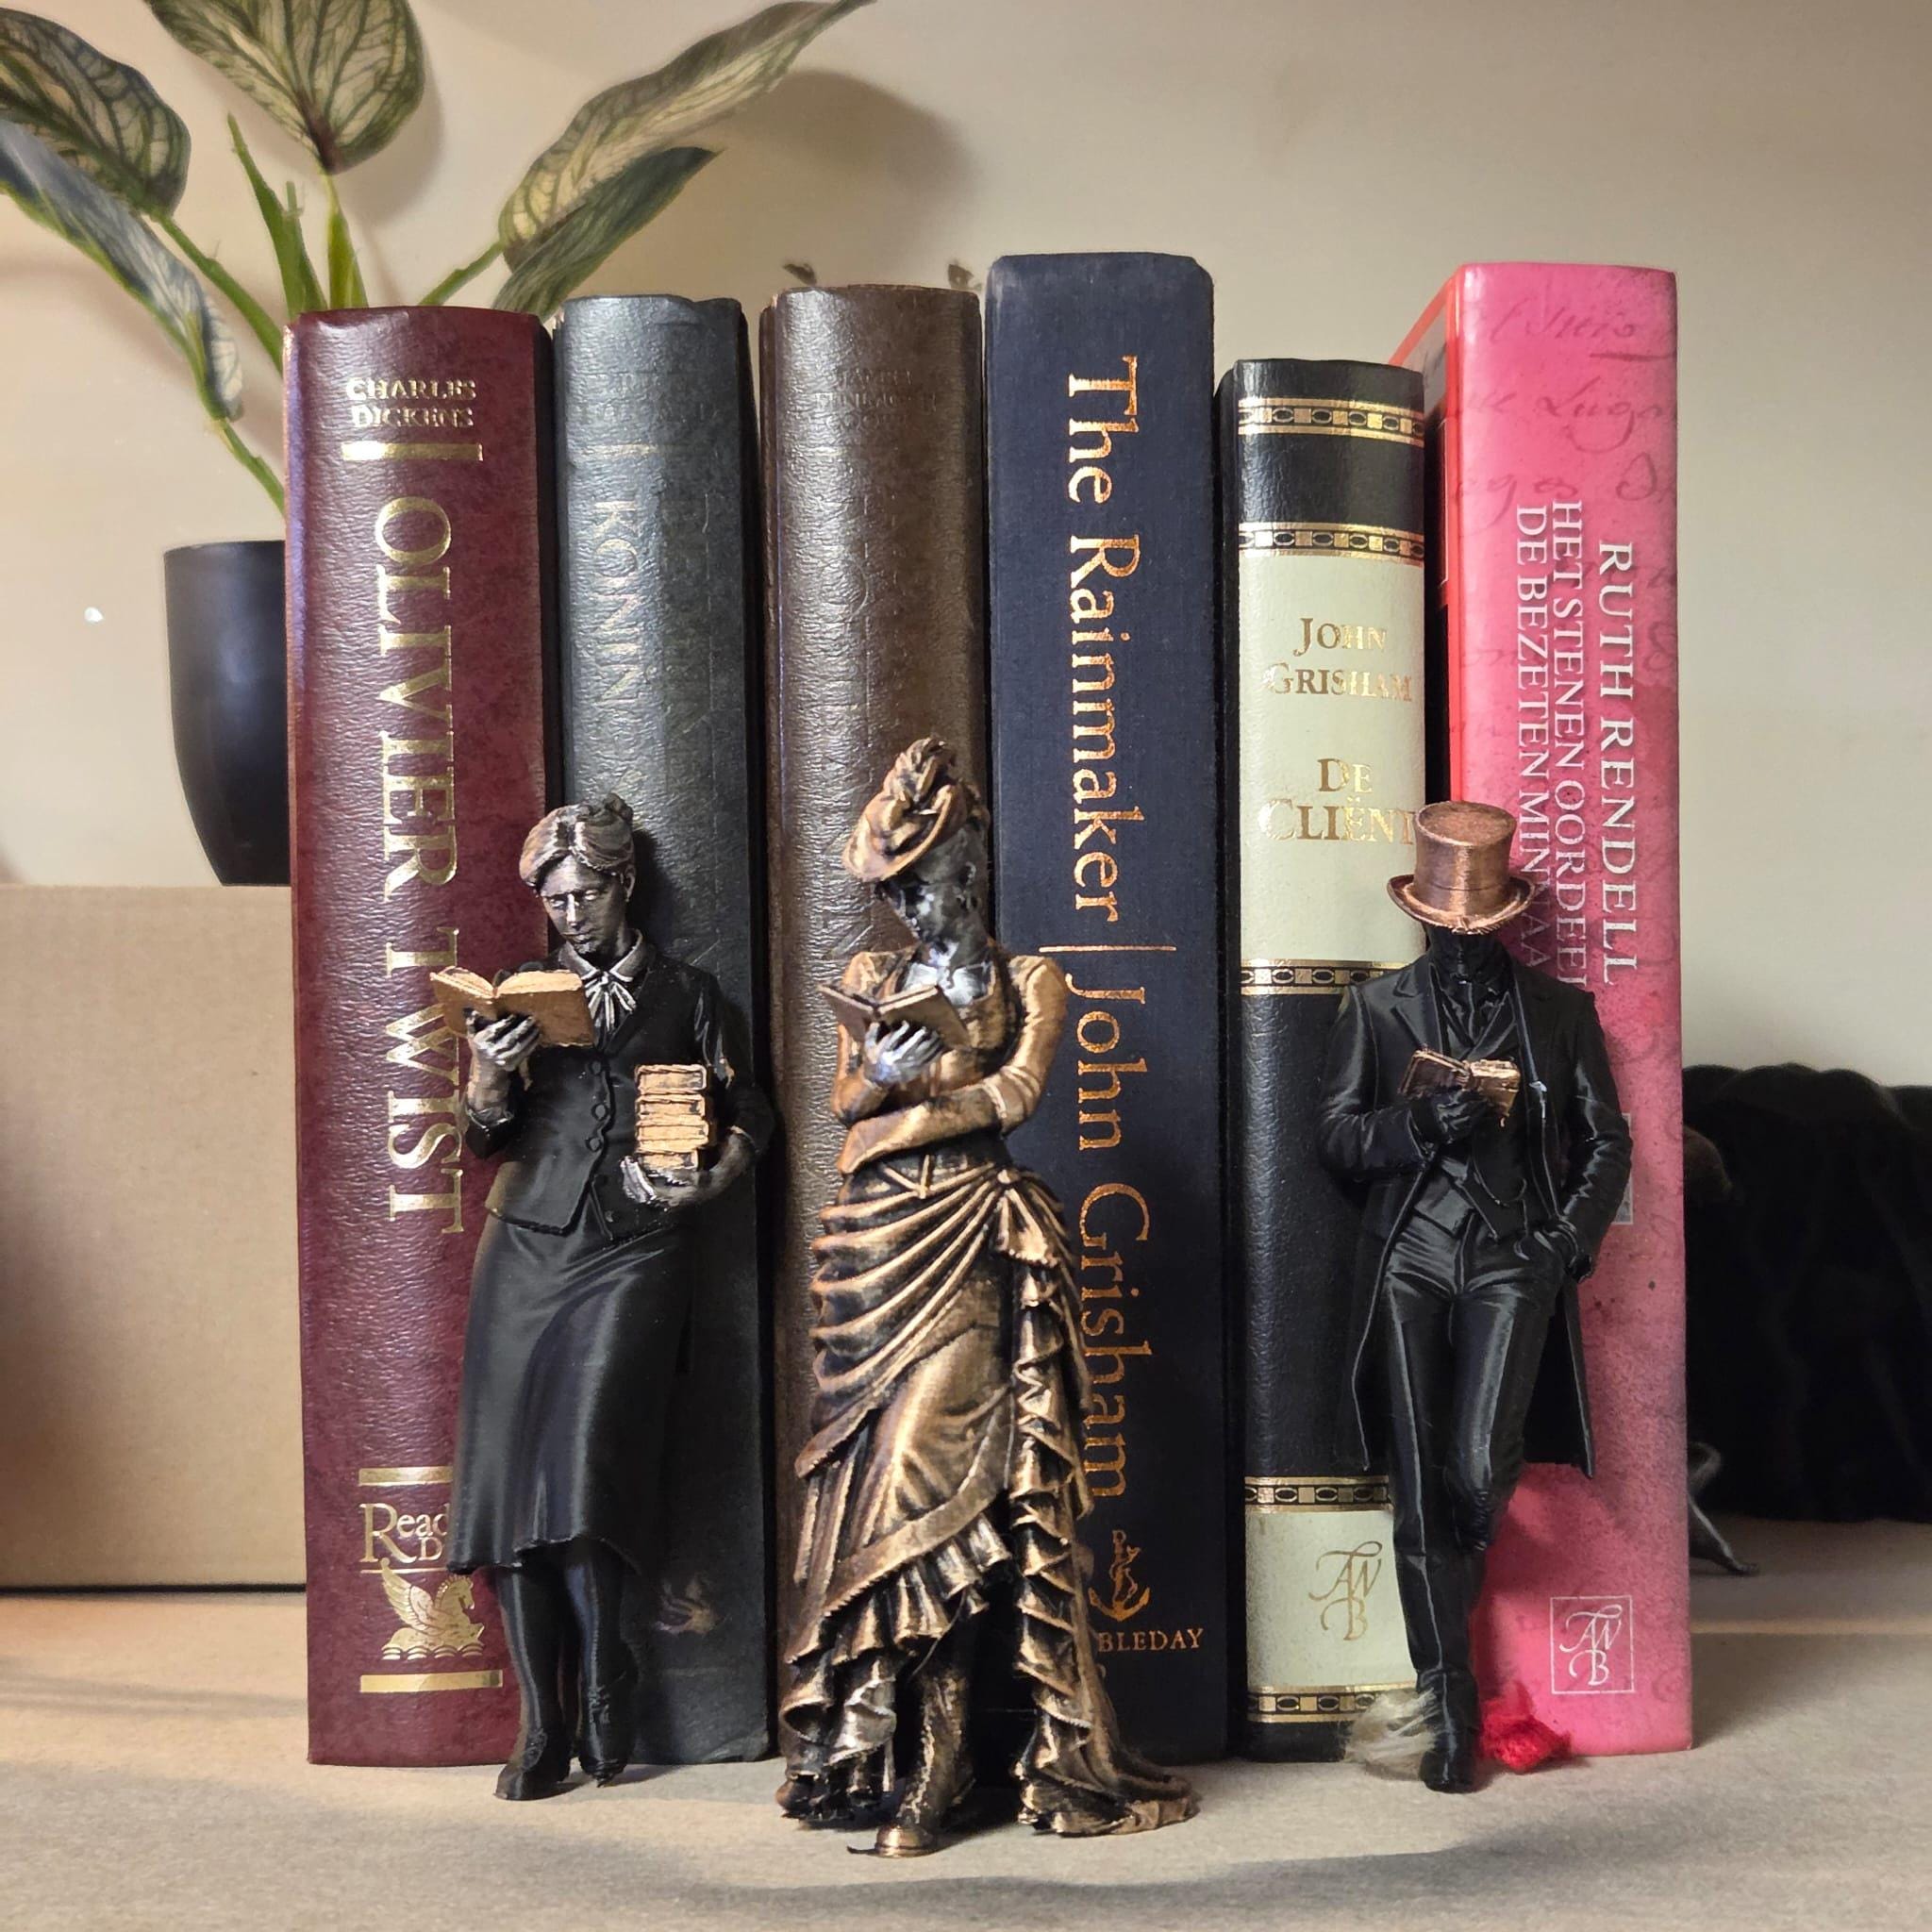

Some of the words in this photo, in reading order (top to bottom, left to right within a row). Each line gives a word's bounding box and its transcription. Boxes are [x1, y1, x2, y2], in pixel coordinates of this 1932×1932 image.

[346, 377, 476, 400] CHARLES
[352, 405, 475, 429] DICKENS
[1067, 355, 1140, 504] The
[1516, 505, 1547, 565] DE
[1552, 500, 1583, 590] HET
[593, 500, 645, 757] KONIN
[1262, 662, 1412, 702] GRISHAM
[1293, 618, 1388, 657] JOHN
[1516, 575, 1550, 779] BEZETEN
[1553, 598, 1585, 770] STENEN
[1598, 541, 1634, 700] RUTH
[375, 496, 458, 900] OLIVER
[1070, 534, 1144, 923] Rainmaker
[1317, 758, 1373, 792] DE
[1257, 796, 1416, 845] CLIËNT
[1599, 717, 1637, 986] RENDELL
[385, 926, 464, 1234] TWIST
[1065, 974, 1147, 1151] John
[1079, 1183, 1152, 1498] Grisham
[1097, 1627, 1204, 1652] BLEDAY
